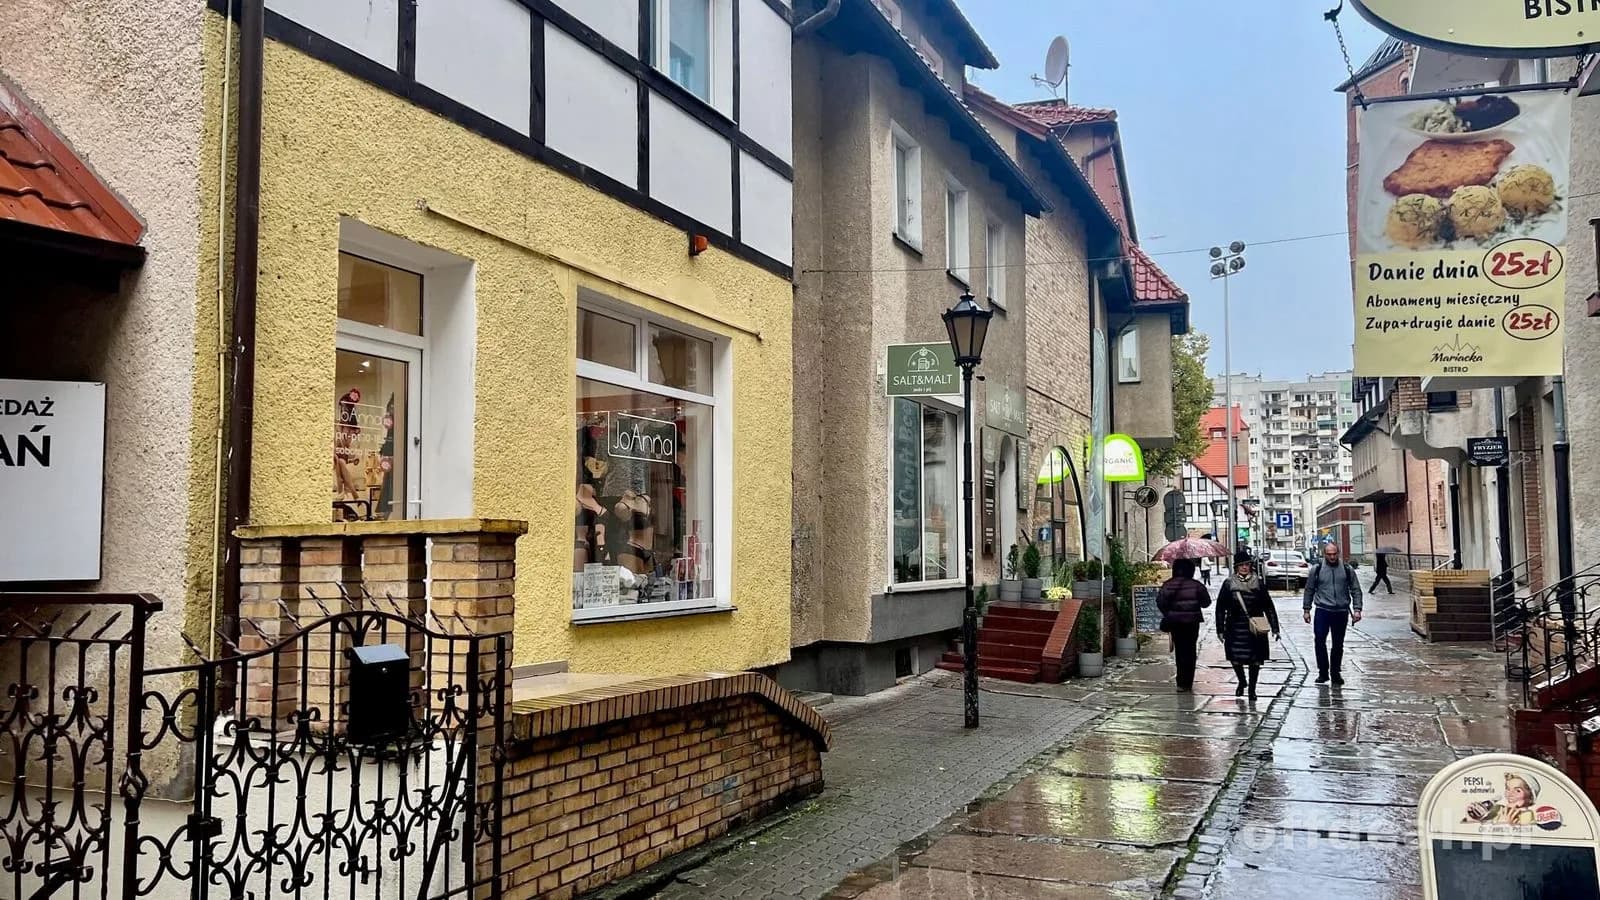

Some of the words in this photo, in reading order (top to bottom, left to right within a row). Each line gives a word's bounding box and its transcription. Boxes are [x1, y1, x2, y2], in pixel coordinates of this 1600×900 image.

[1369, 261, 1425, 281] Danie
[1433, 259, 1479, 279] dnia
[1491, 251, 1553, 277] 25zł
[1366, 294, 1441, 309] Abonameny
[1447, 292, 1520, 307] miesięczny
[1365, 316, 1453, 333] Zupa+drugie
[1458, 315, 1496, 329] danie
[1509, 312, 1553, 331] 25zł
[1430, 351, 1483, 363] Mariacka
[893, 374, 953, 386] SALT&MALT
[0, 396, 54, 417] DAŻ
[612, 420, 674, 457] JoAnna
[1104, 456, 1134, 466] RGANIC
[1280, 514, 1290, 526] P
[1463, 776, 1484, 786] PEPSI
